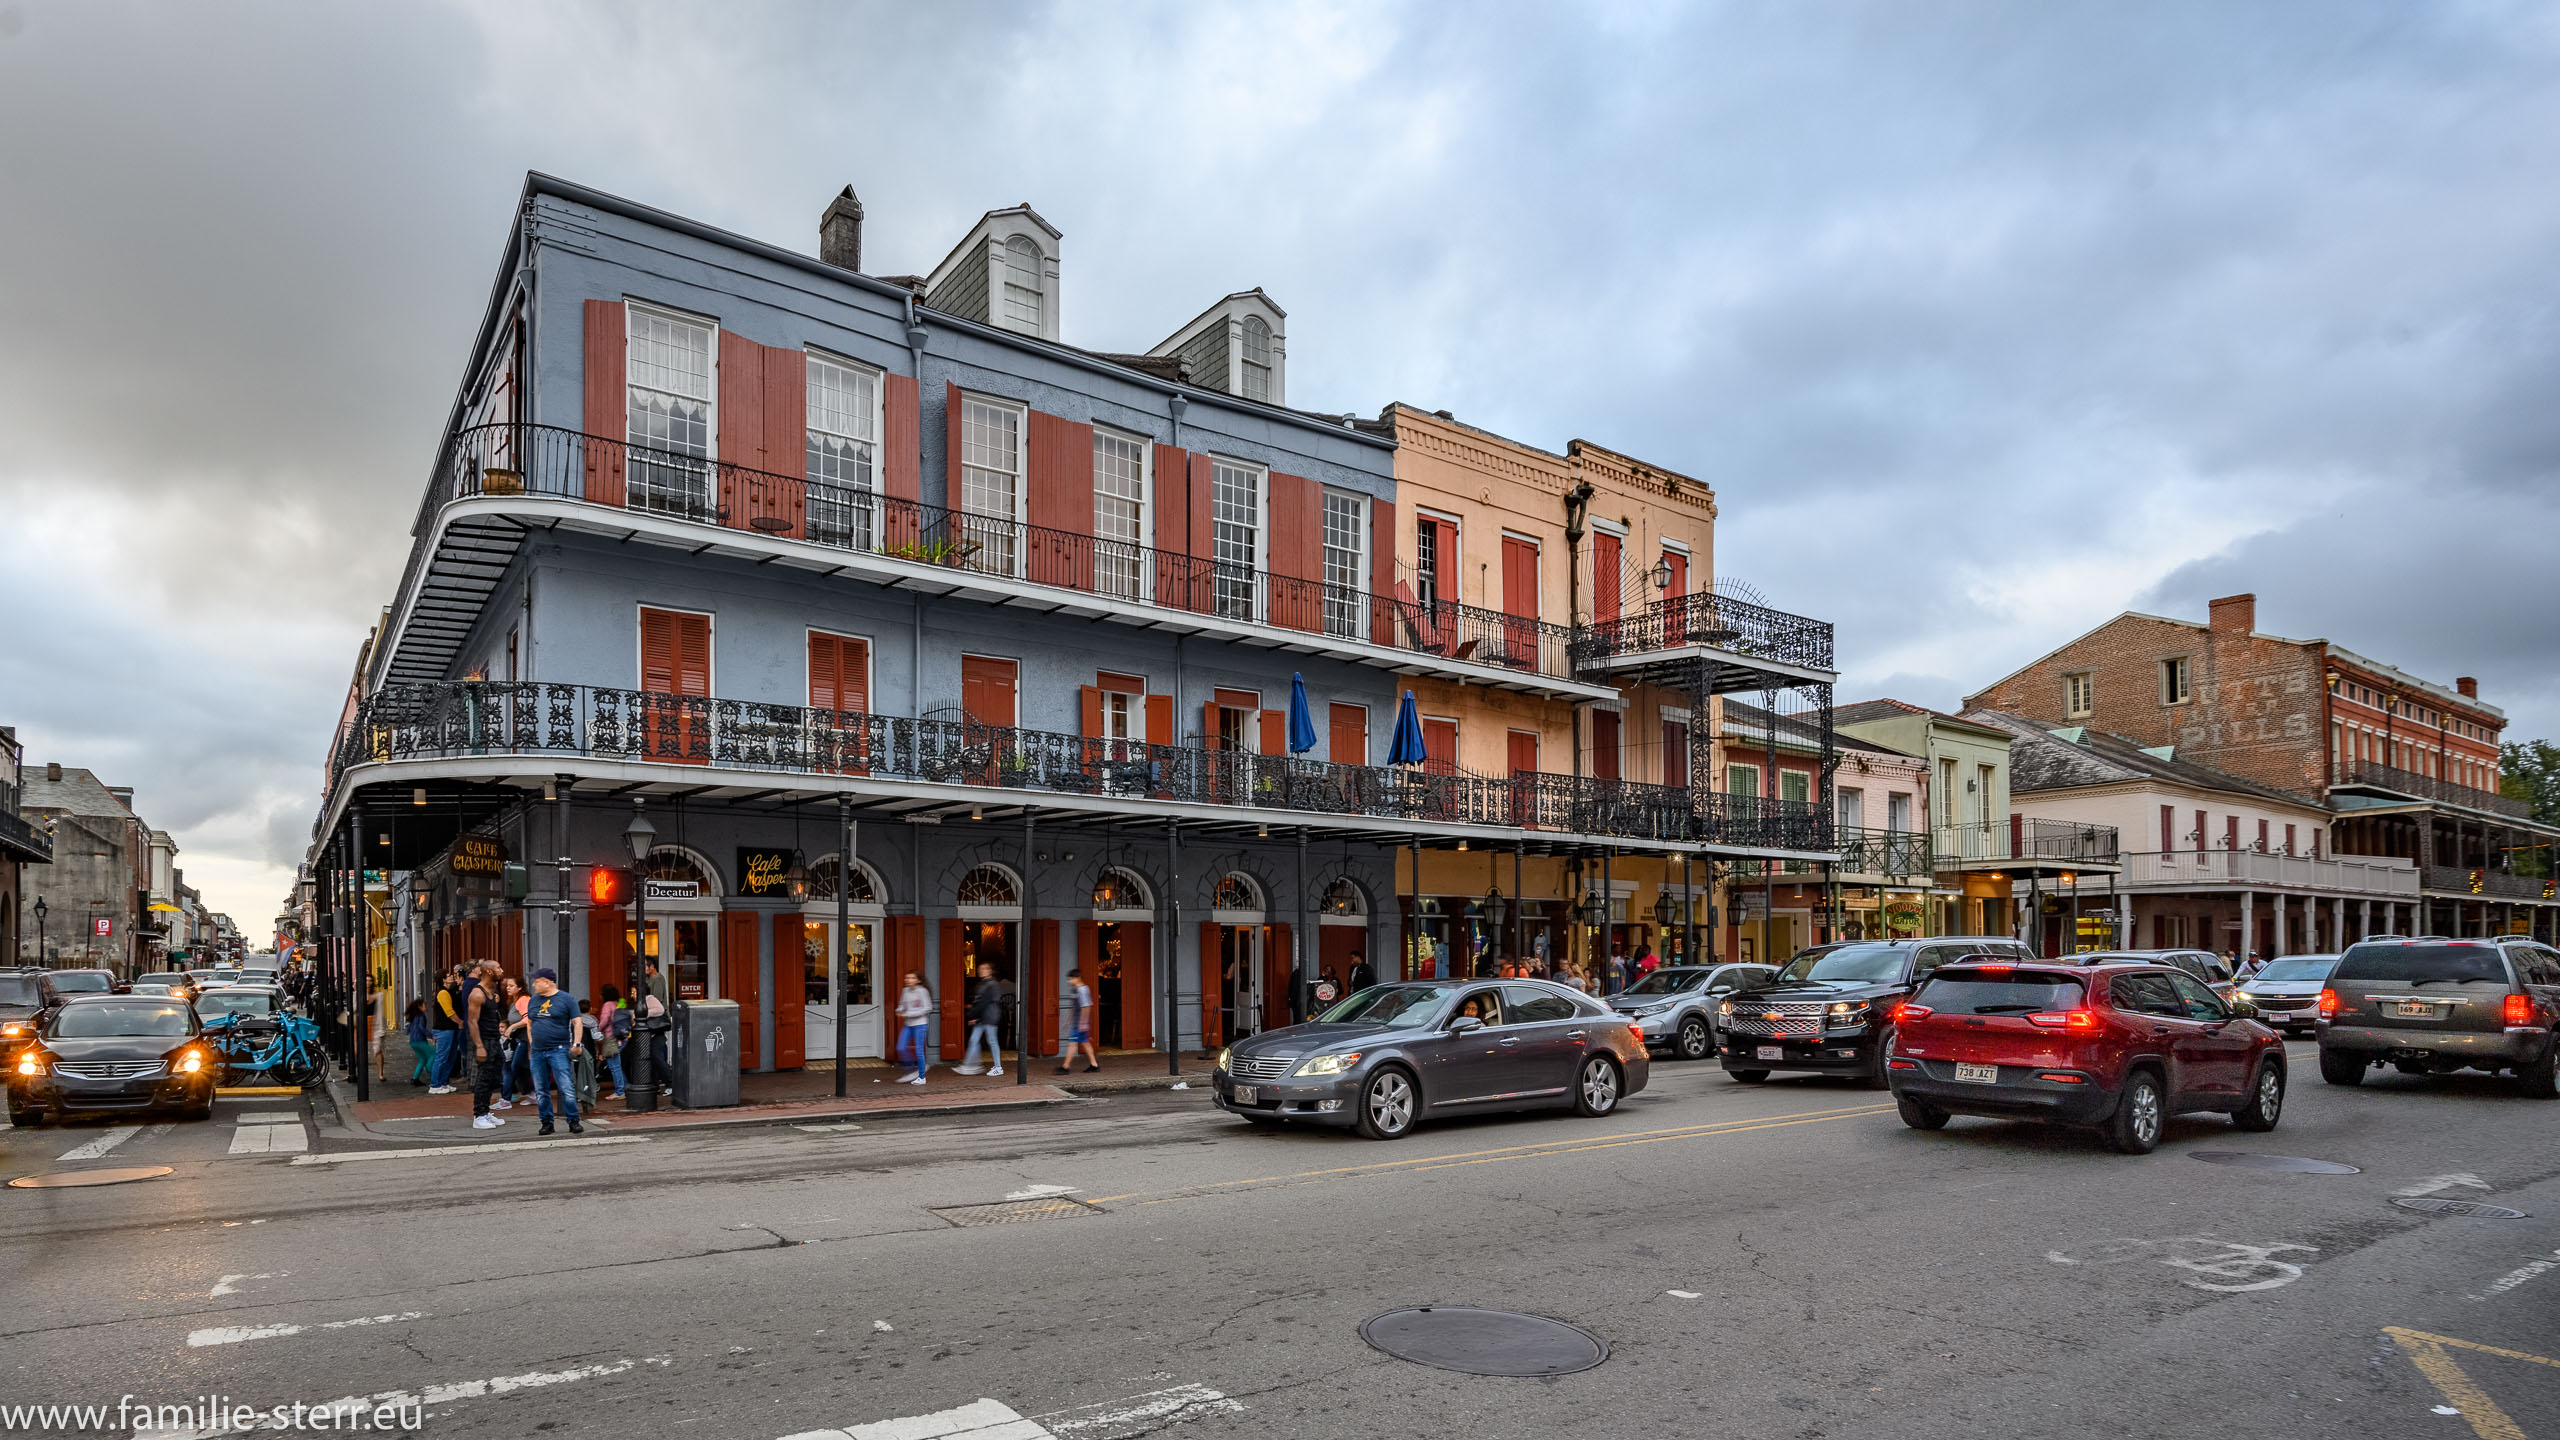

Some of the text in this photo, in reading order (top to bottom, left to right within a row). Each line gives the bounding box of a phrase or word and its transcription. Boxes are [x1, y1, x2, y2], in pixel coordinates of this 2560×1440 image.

[650, 886, 695, 897] Decatur
[1959, 1067, 1995, 1079] 738 AZT
